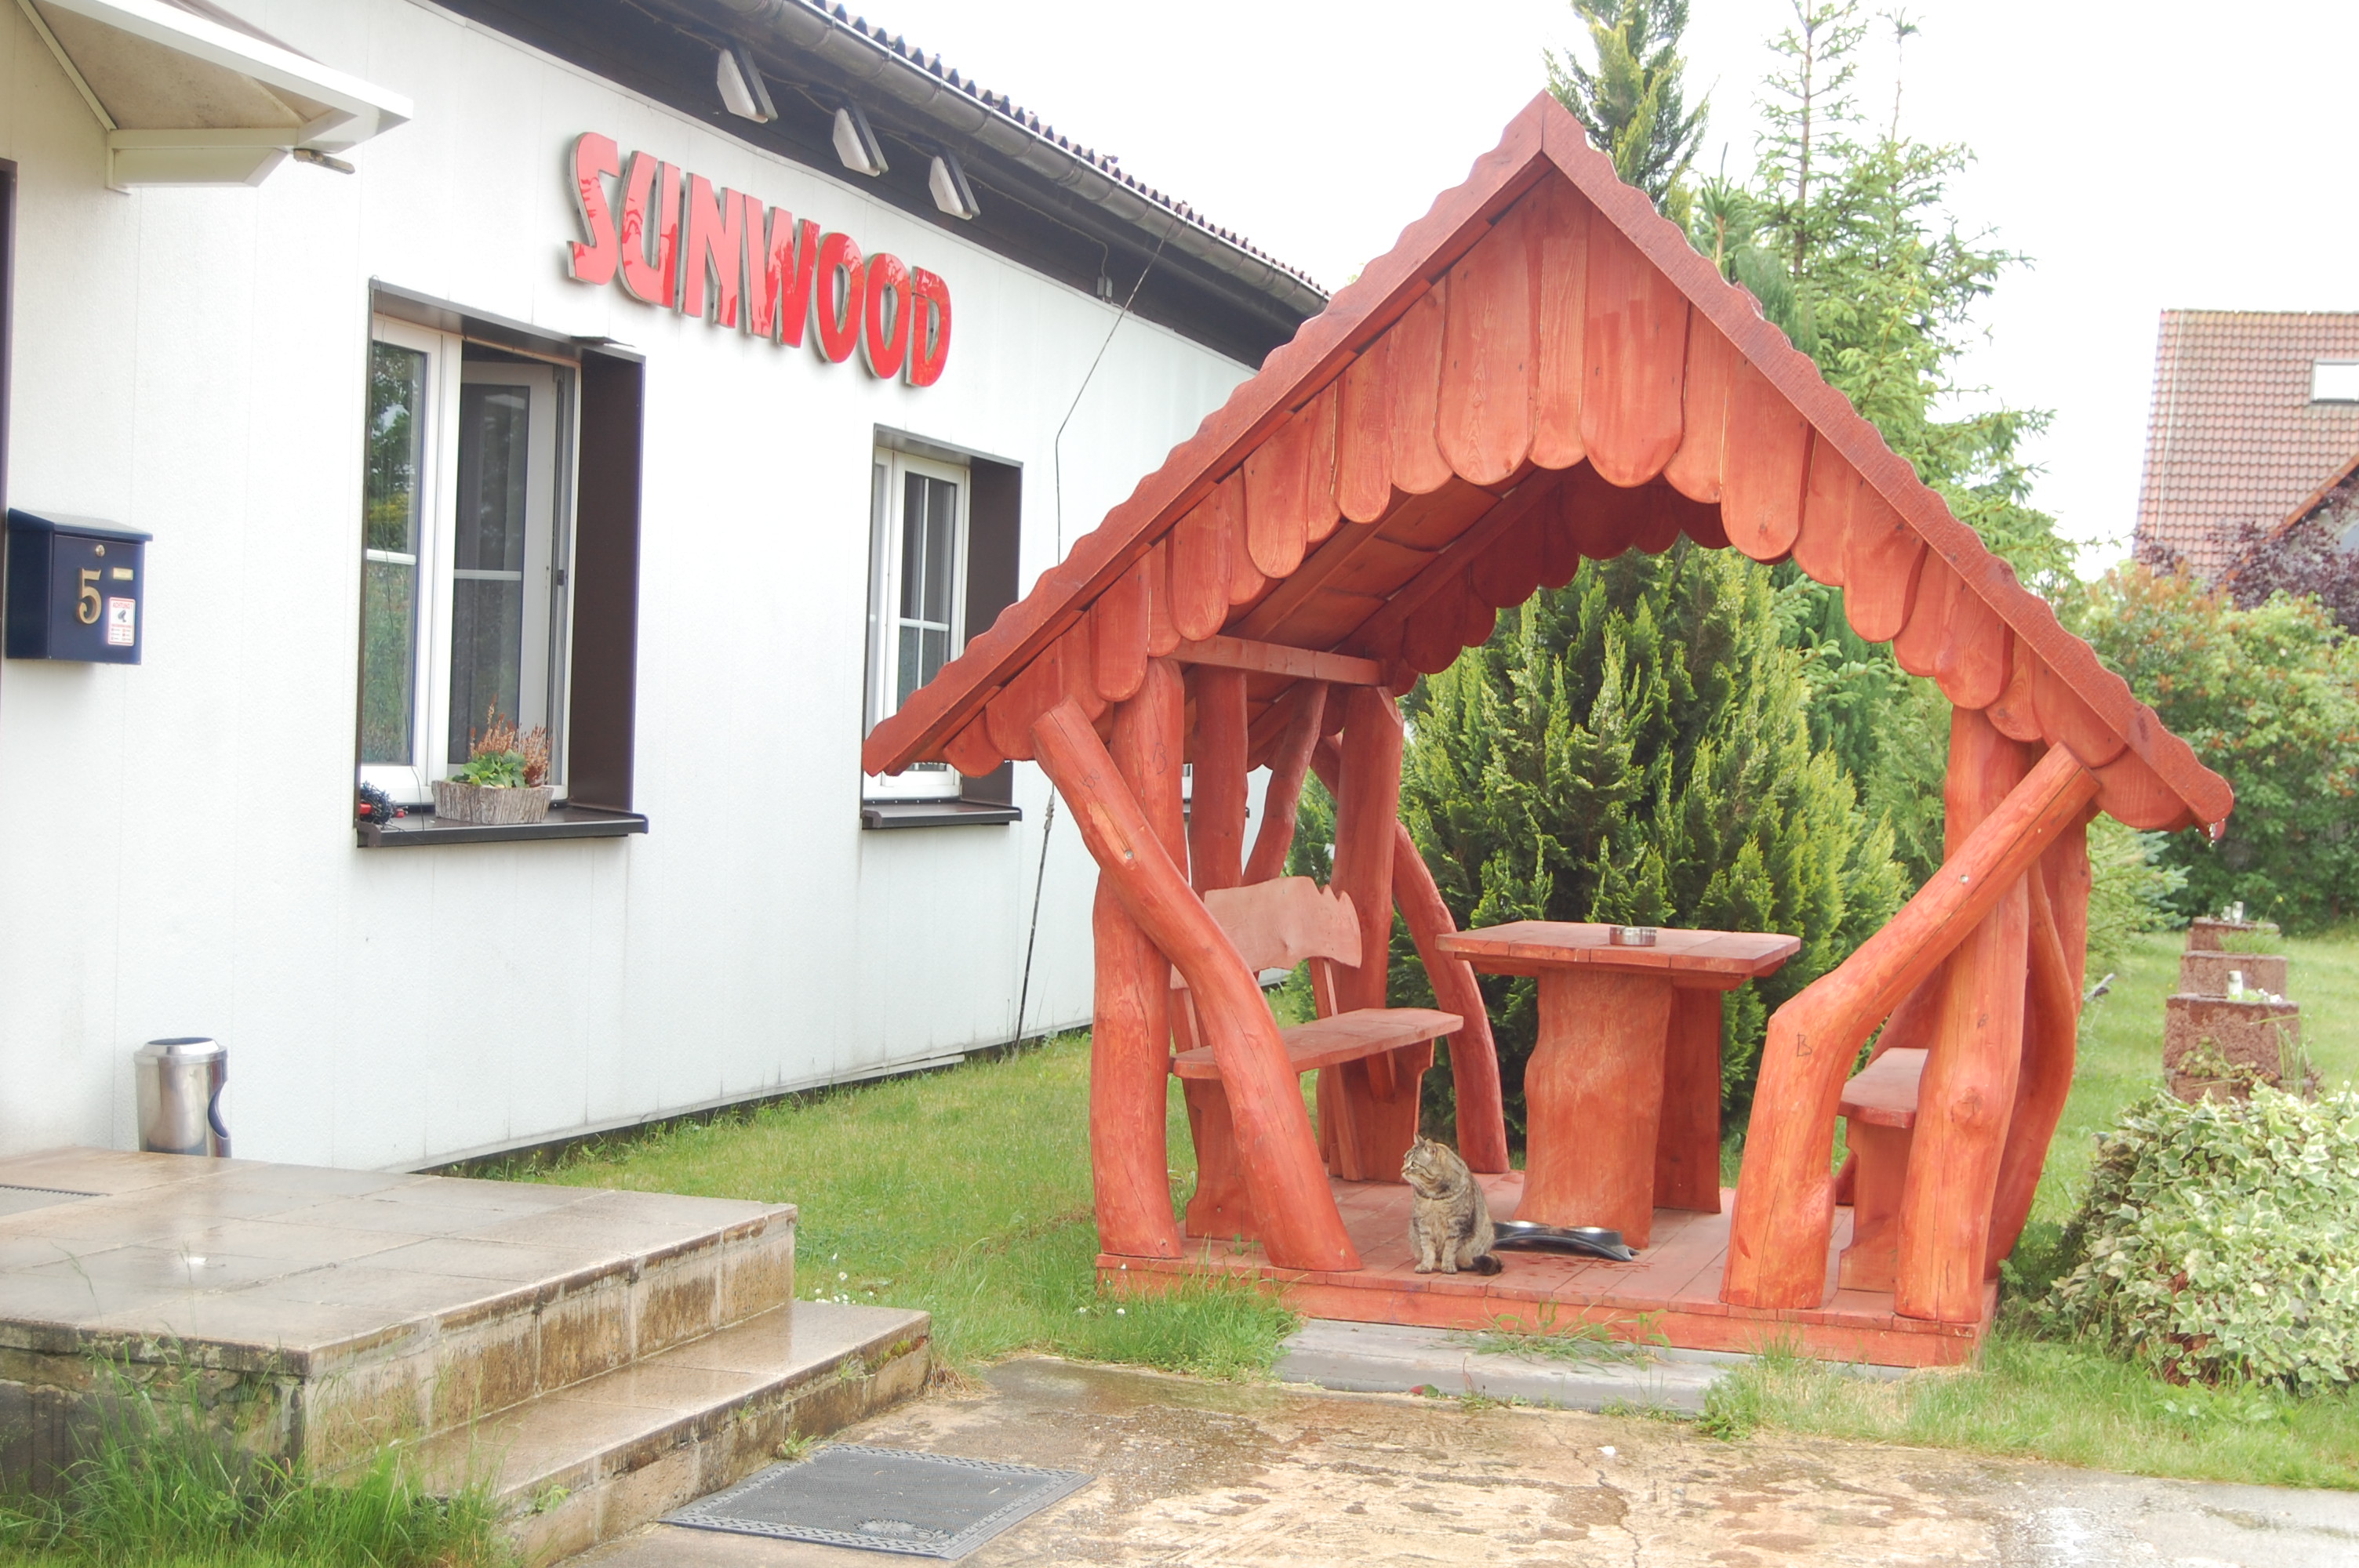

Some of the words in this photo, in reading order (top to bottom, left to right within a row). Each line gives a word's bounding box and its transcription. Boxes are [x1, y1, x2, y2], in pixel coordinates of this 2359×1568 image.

[567, 132, 952, 387] SUNWOOD
[78, 568, 102, 625] 5
[1796, 1032, 1813, 1058] B
